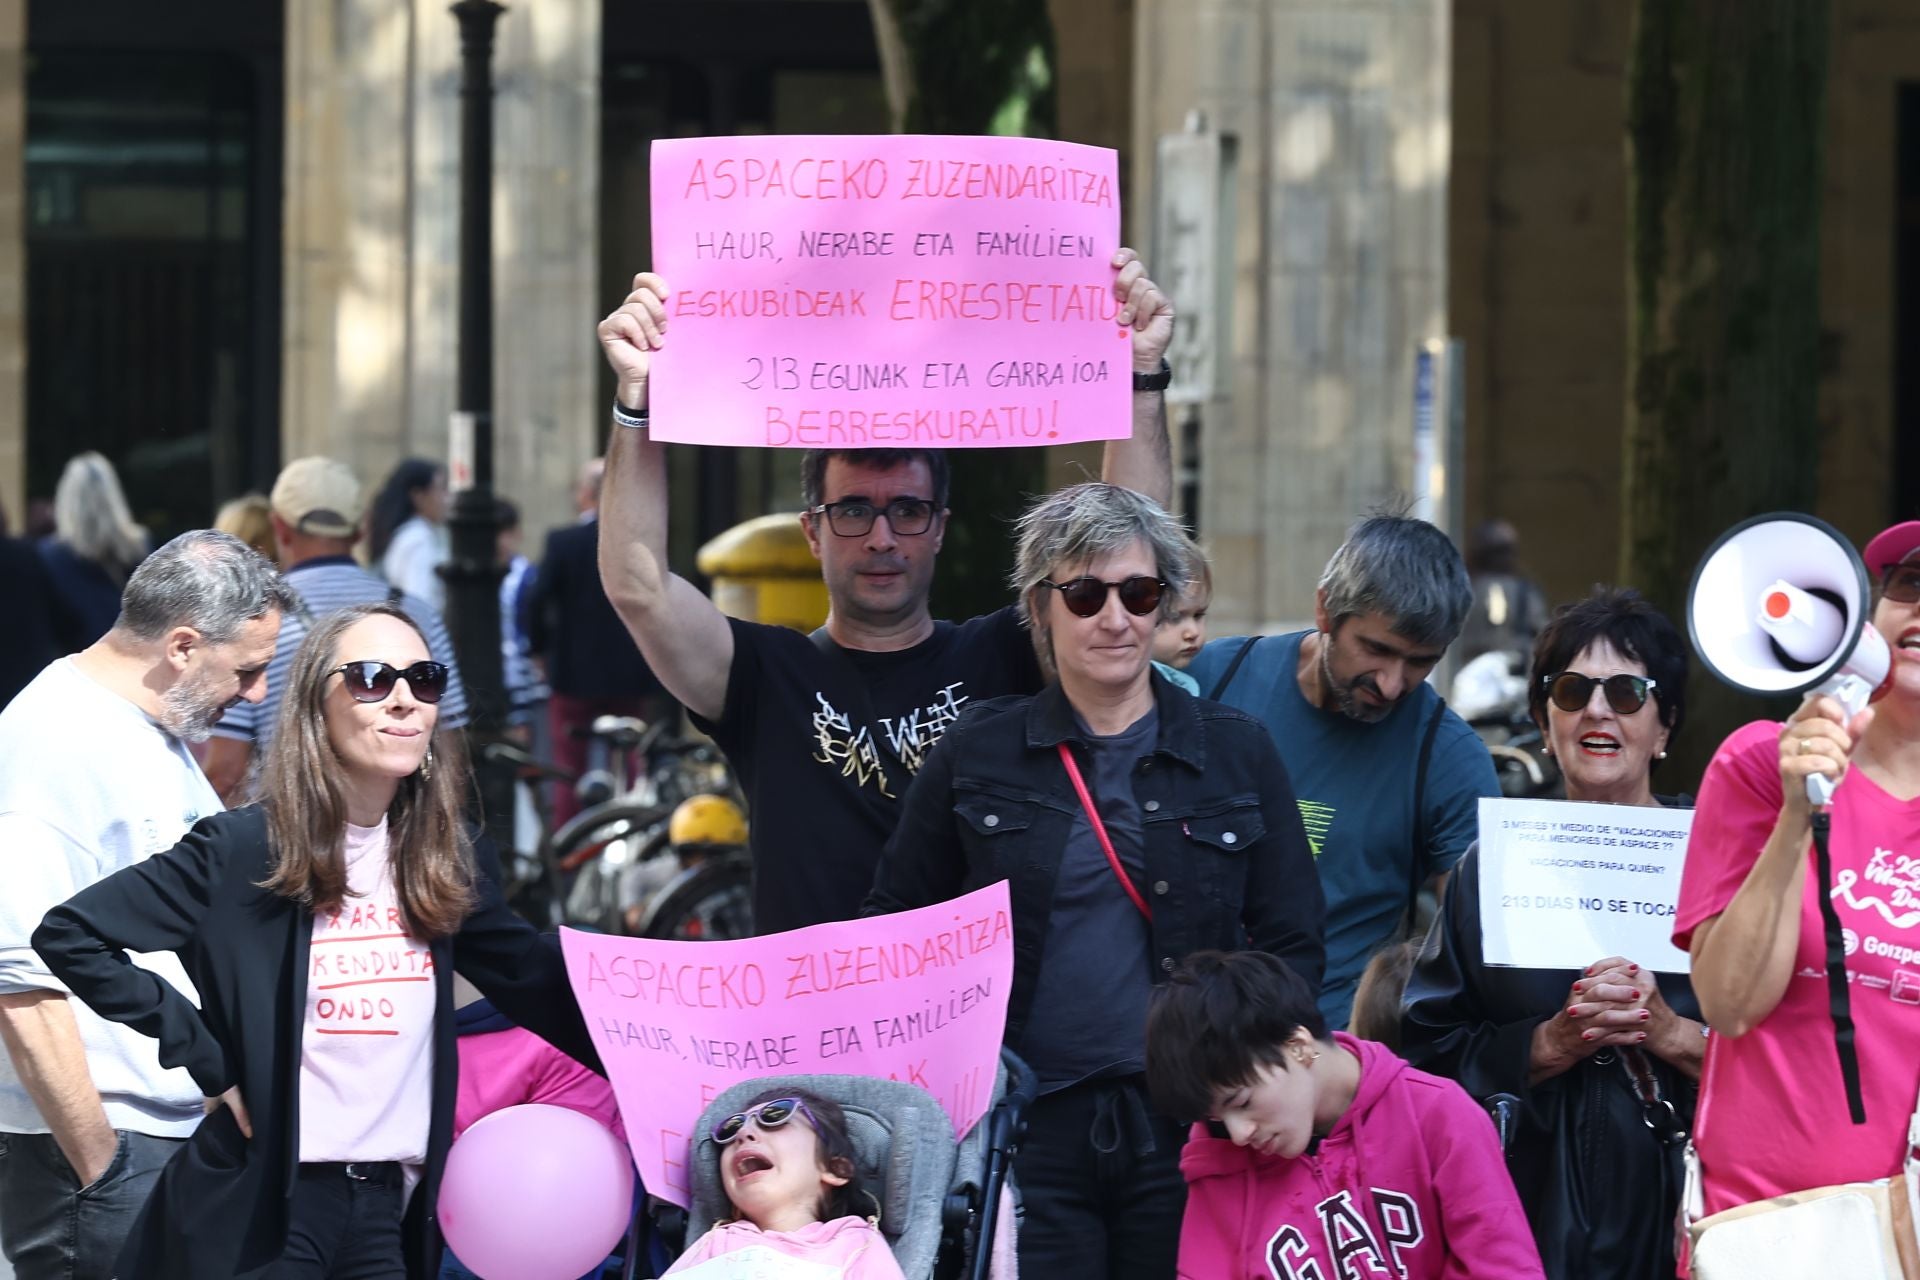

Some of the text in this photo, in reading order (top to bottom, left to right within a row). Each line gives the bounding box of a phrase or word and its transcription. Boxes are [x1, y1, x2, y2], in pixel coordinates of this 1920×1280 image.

[685, 158, 888, 201] ASPACEKO
[696, 231, 782, 264] HAUR,
[798, 230, 895, 258] NERABE
[913, 231, 955, 257] ETA
[740, 357, 801, 392] 213
[811, 361, 909, 391] EGUNAK
[922, 361, 970, 390] ETA
[766, 399, 1060, 447] BERRESKURATU!
[1502, 820, 1510, 830] 3
[1550, 821, 1557, 831] Y
[1559, 822, 1594, 834] MEDIO
[1597, 824, 1611, 835] DE
[1549, 834, 1601, 847] MENORES
[1603, 837, 1618, 848] DE
[1619, 838, 1661, 851] ASPACE
[1529, 858, 1595, 870] VACACIONES
[1597, 860, 1626, 872] PARA
[1501, 894, 1531, 909] 213
[1578, 897, 1604, 912] NO
[1607, 898, 1629, 914] SE
[1634, 900, 1678, 917] TOCA
[312, 950, 436, 977] KENDUTA
[587, 951, 766, 1010] ASPACEKO
[316, 997, 395, 1021] ONDO
[693, 1034, 799, 1071] NERABE
[819, 1025, 863, 1060] ETA
[1265, 1186, 1425, 1280] GAP
